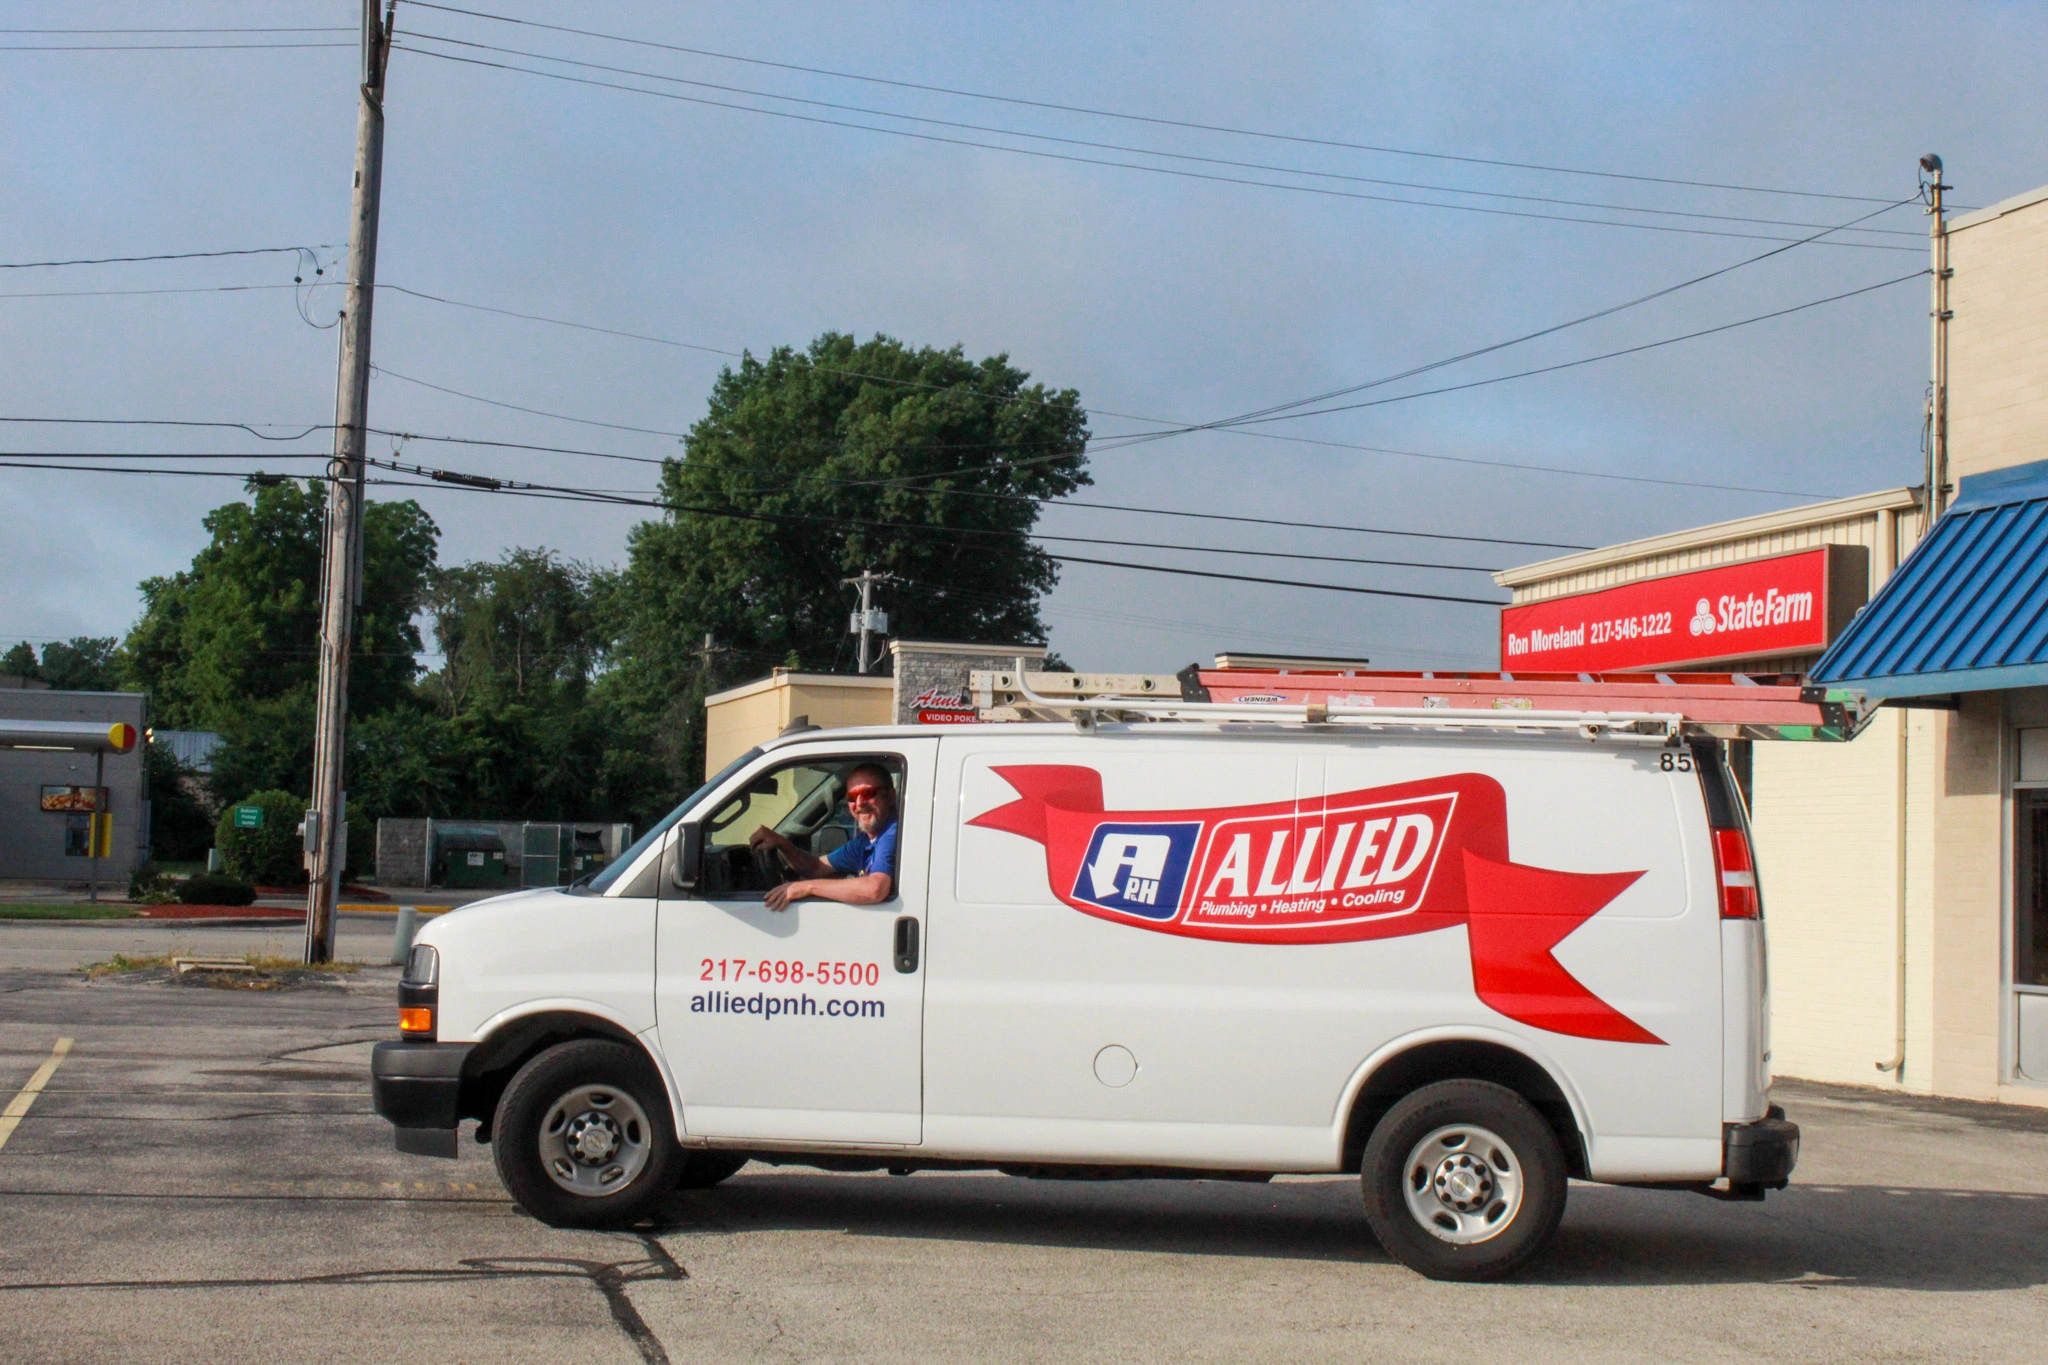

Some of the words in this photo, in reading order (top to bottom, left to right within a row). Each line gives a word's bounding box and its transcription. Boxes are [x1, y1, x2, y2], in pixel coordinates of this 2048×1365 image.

[1508, 633, 1529, 656] Ron
[1531, 622, 1585, 653] Moreland
[1590, 611, 1672, 645] 217-546-1222
[926, 713, 952, 722] VIDEO
[954, 714, 981, 724] POKE
[1660, 752, 1691, 772] 85
[1203, 813, 1434, 898] ALLIED
[1199, 900, 1257, 918] Plumbing
[1270, 896, 1326, 915] Heating
[1342, 888, 1406, 908] Cooling
[700, 958, 880, 986] 217-698-5500
[690, 990, 885, 1020] alliedpnh.com
